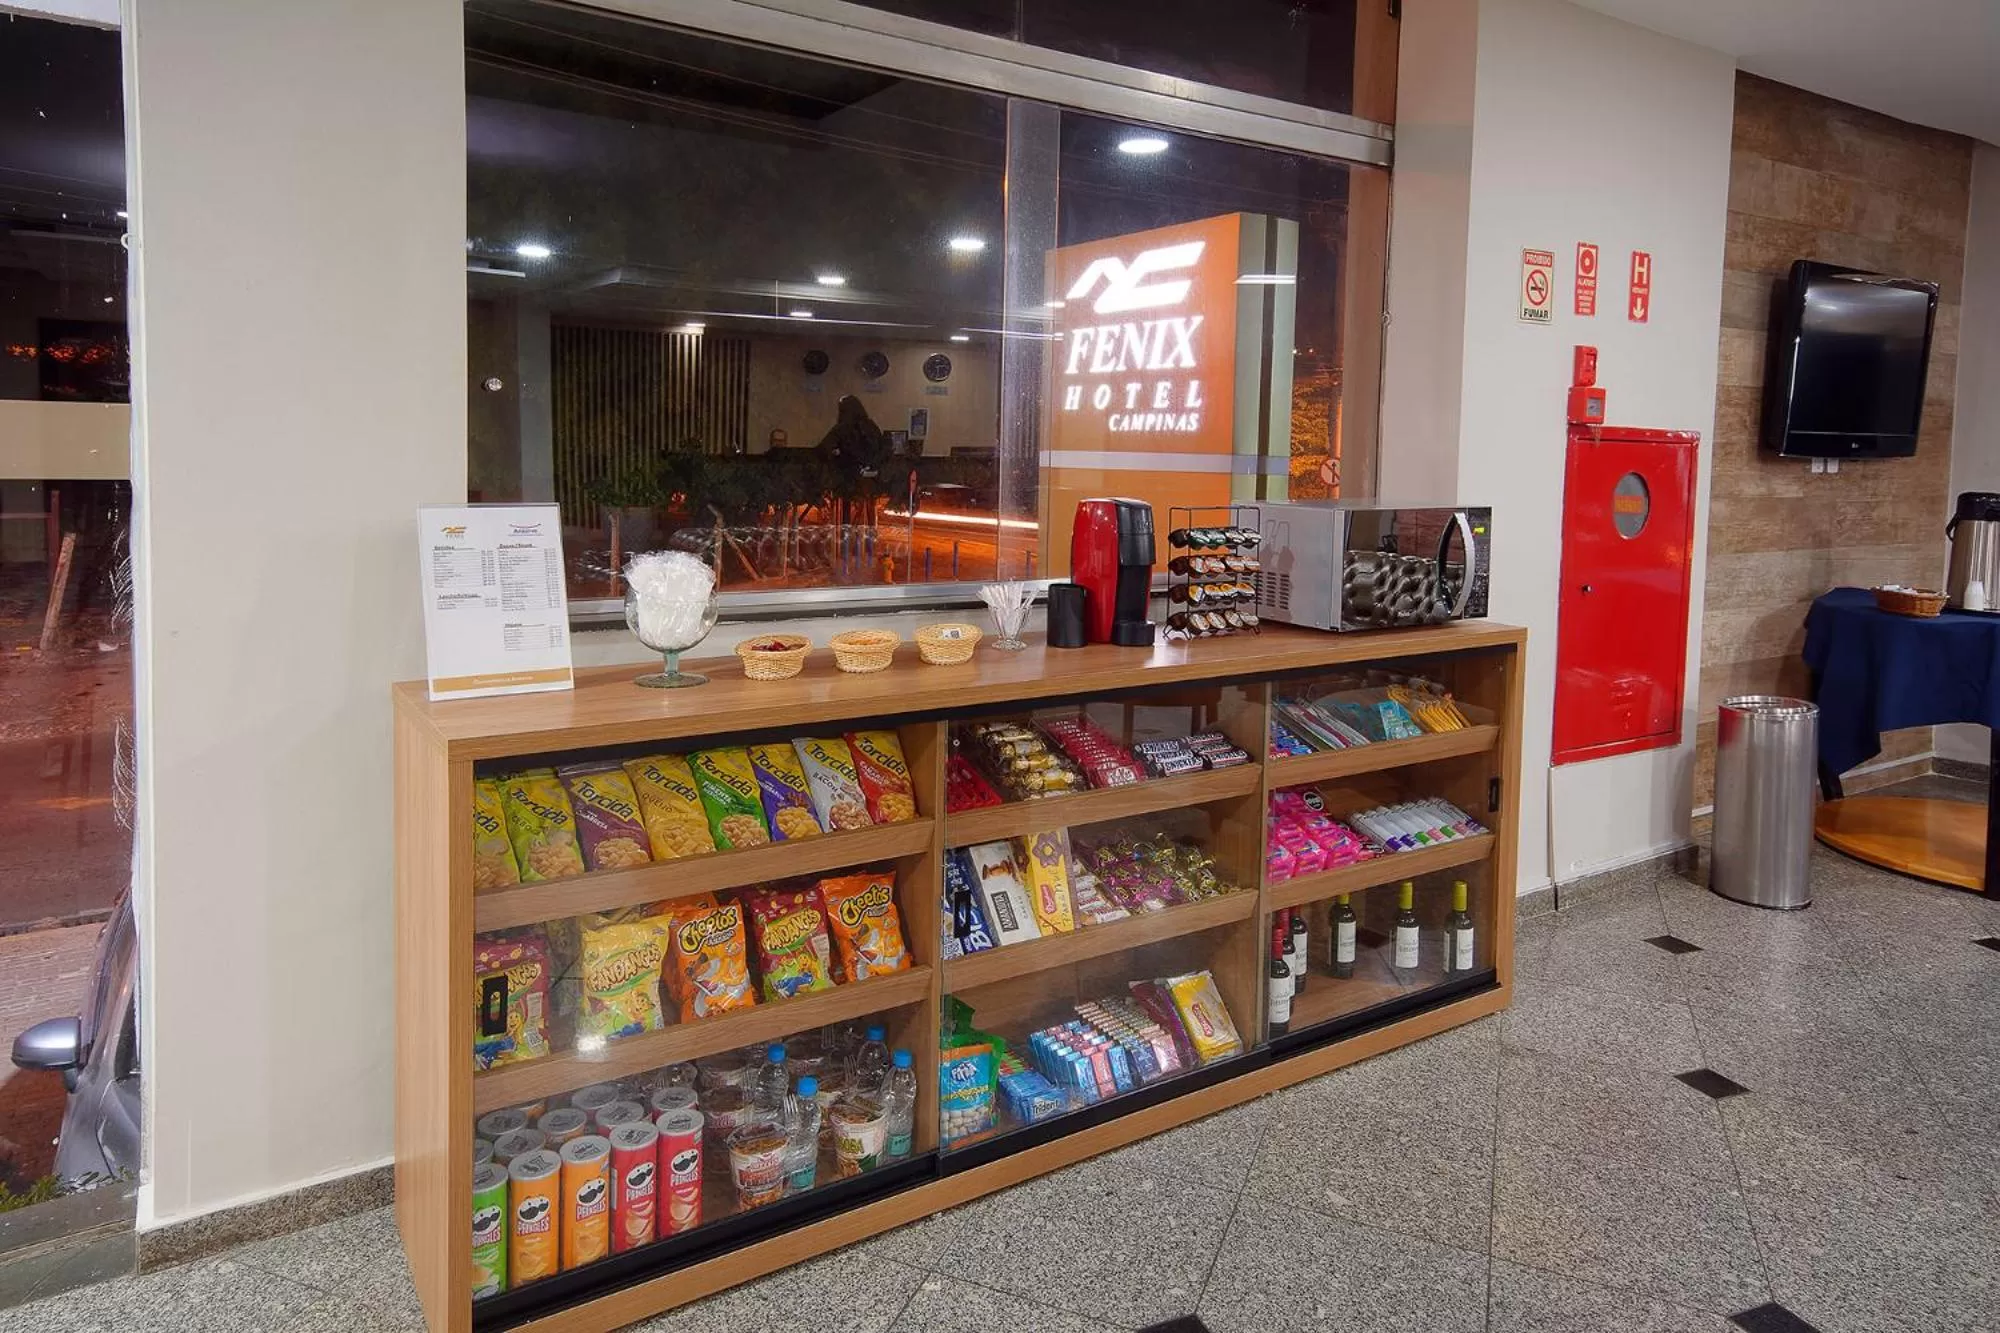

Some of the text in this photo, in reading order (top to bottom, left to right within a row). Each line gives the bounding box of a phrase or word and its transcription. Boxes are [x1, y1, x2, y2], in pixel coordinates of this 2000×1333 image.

[1633, 255, 1649, 285] H
[1523, 308, 1549, 319] FUMAR
[1065, 315, 1205, 375] FENIX
[1064, 381, 1203, 411] HOTEL
[1108, 413, 1200, 432] CAMPINAS
[755, 750, 805, 791] Torcida
[809, 743, 858, 783] Torcida
[860, 736, 907, 776] Torcida
[1164, 757, 1204, 773] SNICKERS
[642, 765, 698, 803] Torcida
[700, 755, 754, 797] Torcida
[511, 787, 569, 826] Torcida
[575, 781, 634, 820] Torcida
[840, 885, 891, 926] Cheetos
[678, 907, 738, 954] Cheetos
[762, 908, 822, 951] FANDANGOS
[587, 943, 662, 992] FANDANGOS
[1032, 1099, 1060, 1114] Trident
[517, 1215, 551, 1236] PRINGLES
[576, 1198, 607, 1221] PRINGLES
